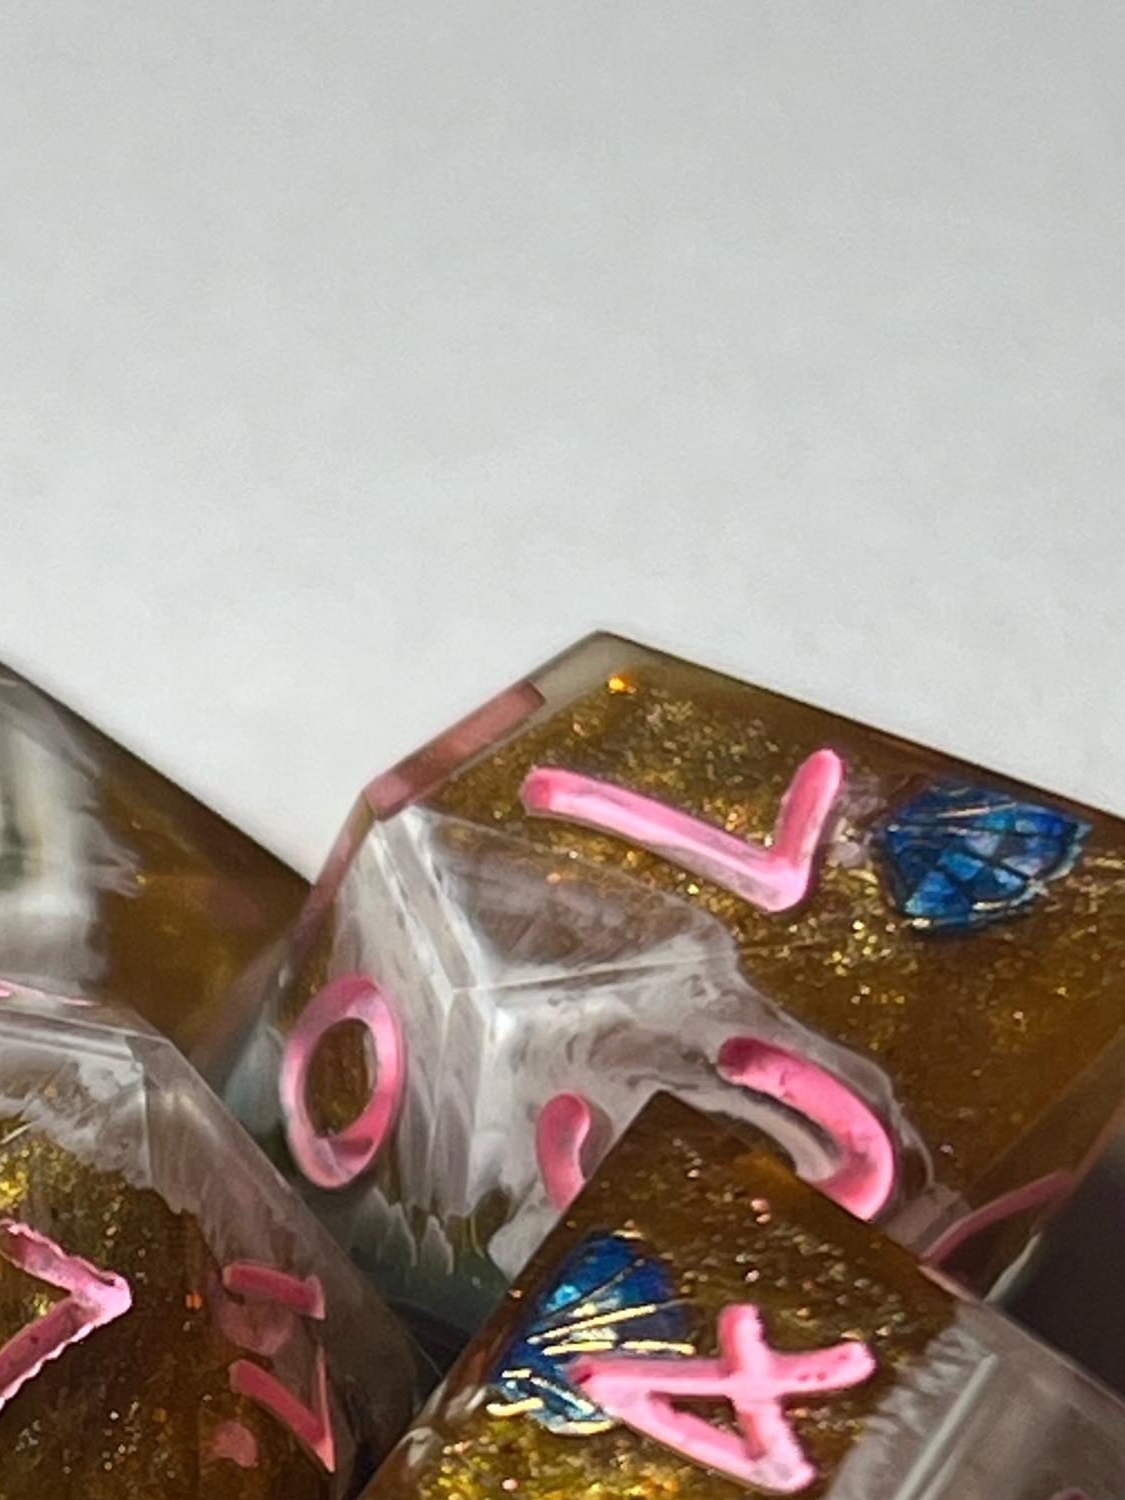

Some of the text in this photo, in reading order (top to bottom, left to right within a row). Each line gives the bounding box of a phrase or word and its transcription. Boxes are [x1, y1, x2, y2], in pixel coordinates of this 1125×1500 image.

[520, 747, 844, 912] 7
[280, 974, 405, 1188] 0
[571, 1304, 875, 1494] 4
